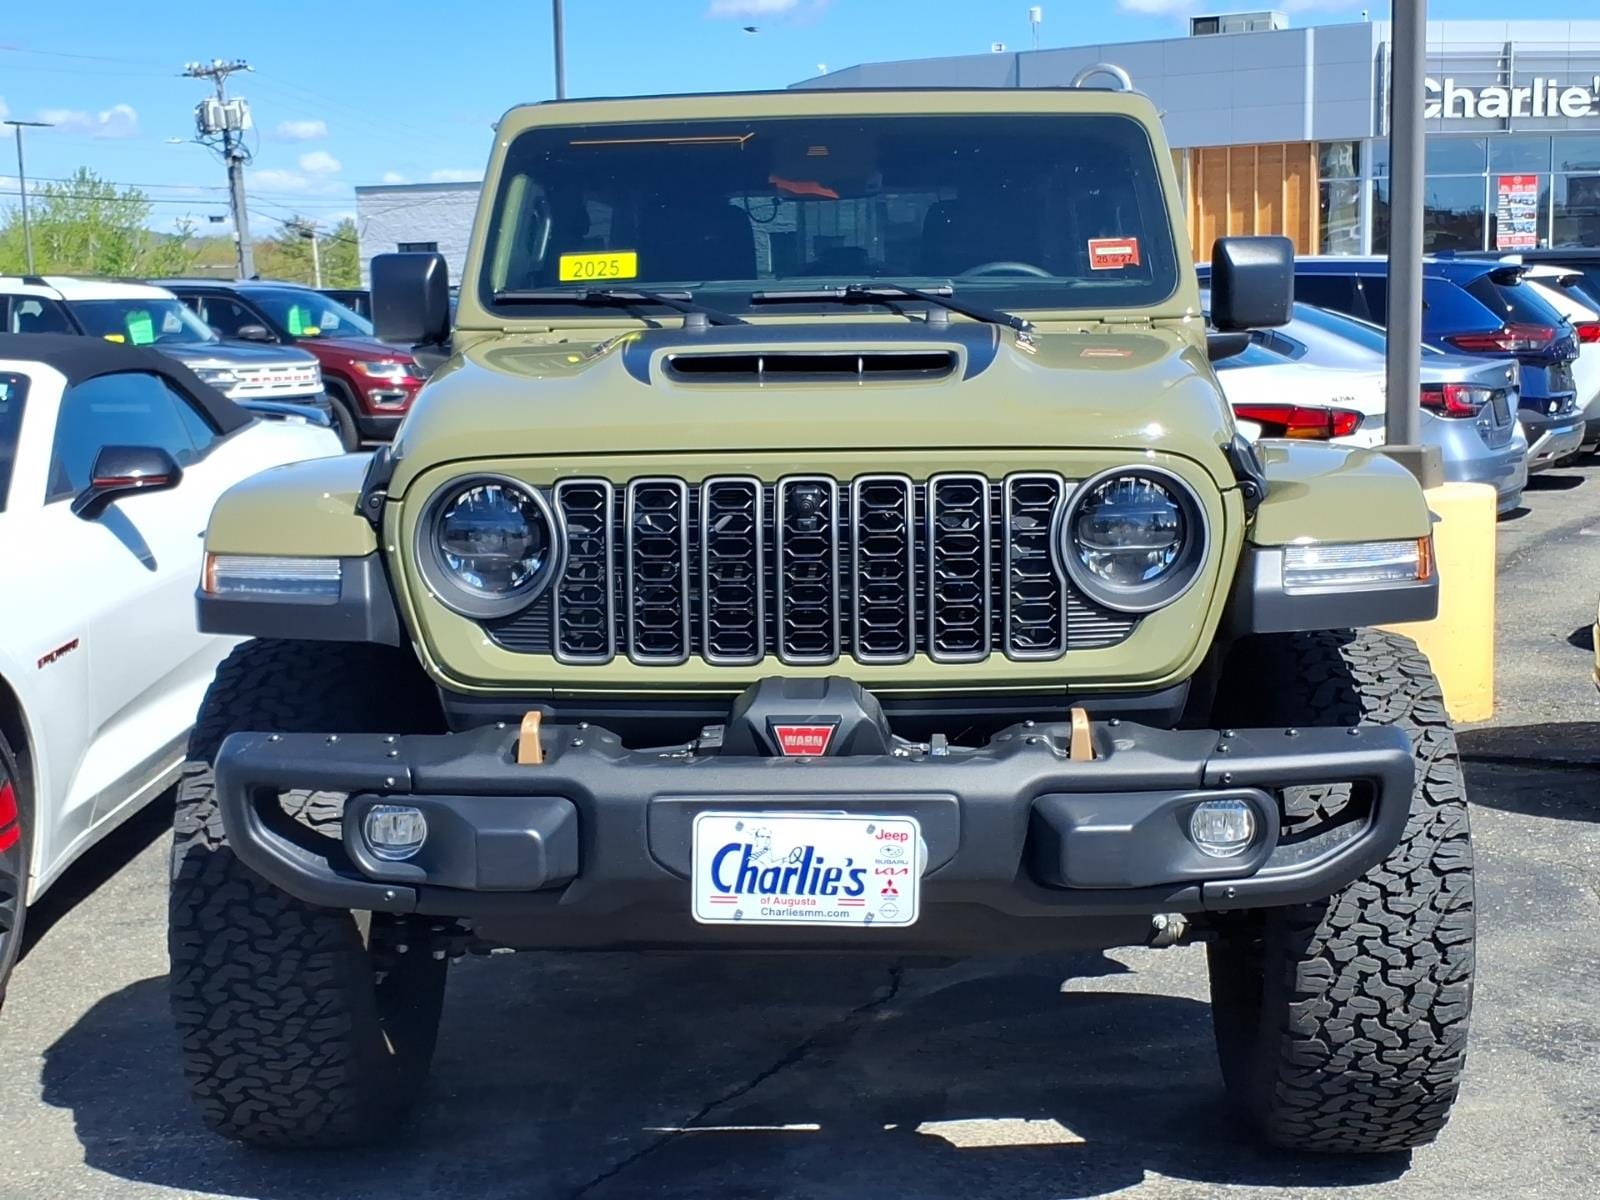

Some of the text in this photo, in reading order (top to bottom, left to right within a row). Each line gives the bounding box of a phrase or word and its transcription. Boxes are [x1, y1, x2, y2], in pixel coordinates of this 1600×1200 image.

[573, 260, 620, 277] 2025
[784, 735, 823, 747] WARN
[875, 829, 909, 843] Jeep
[711, 843, 867, 897] Charlie's
[875, 867, 909, 875] KIA
[760, 896, 817, 908] of Augusta
[760, 906, 850, 918] Charliesmm.com
